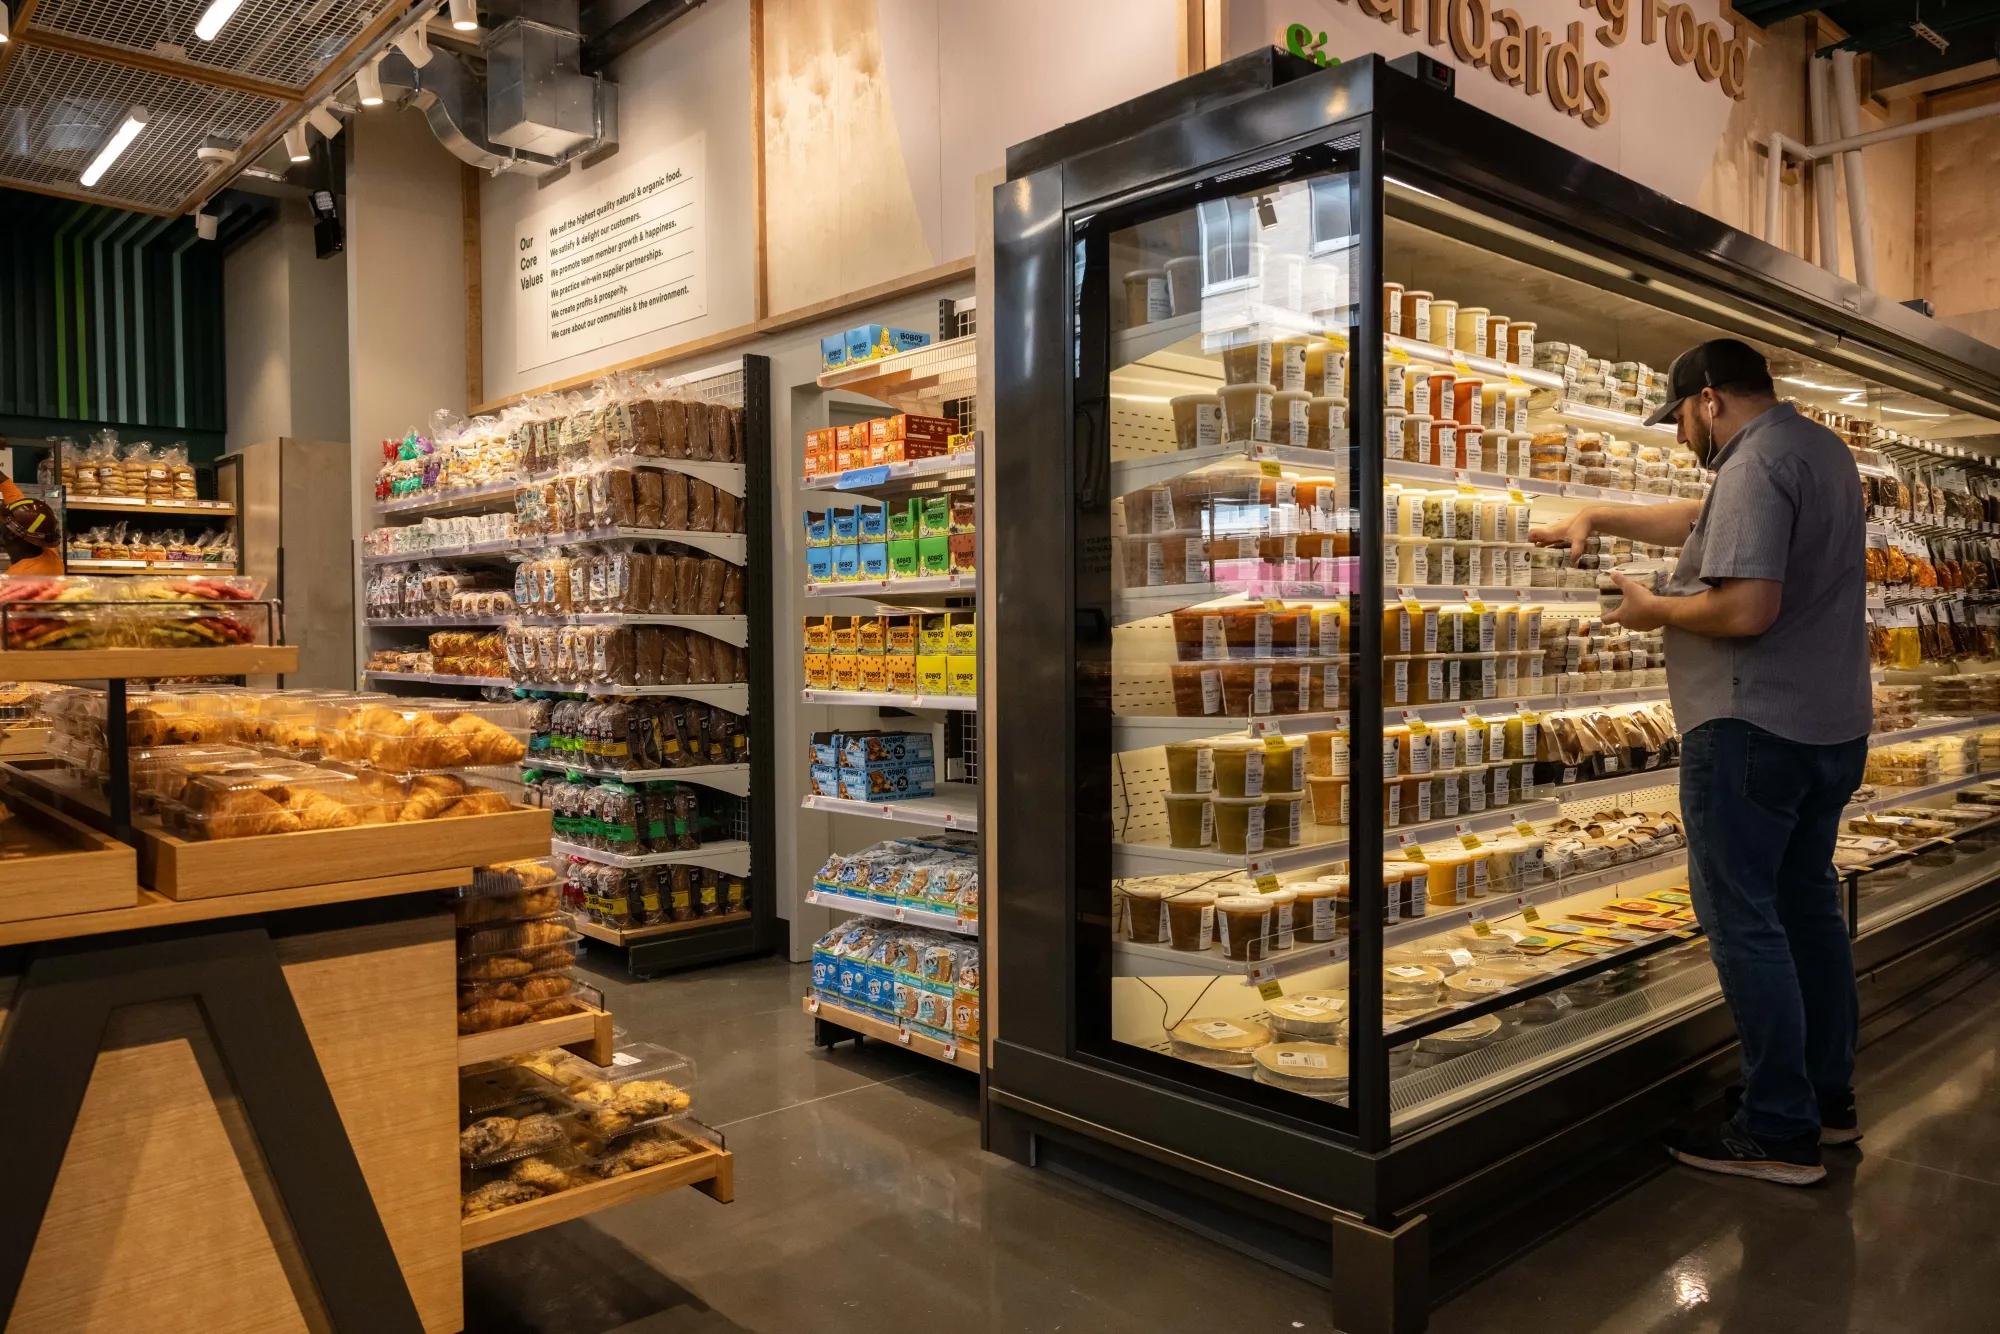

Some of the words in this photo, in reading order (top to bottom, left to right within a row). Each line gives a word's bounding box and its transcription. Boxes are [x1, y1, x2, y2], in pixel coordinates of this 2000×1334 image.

[550, 228, 558, 237] We
[558, 222, 567, 233] sell
[567, 219, 576, 228] the
[576, 209, 596, 225] highest
[596, 200, 616, 216] quality
[616, 188, 637, 206] natural
[637, 186, 642, 197] &
[642, 176, 665, 194] organic
[666, 168, 682, 183] food.
[550, 248, 558, 258] We
[559, 240, 575, 254] satisfy
[576, 237, 581, 246] &
[581, 228, 600, 244] delight
[601, 226, 609, 235] our
[610, 212, 641, 231] customers.
[520, 237, 534, 251] Our
[550, 268, 559, 278] We
[559, 258, 580, 274] promote
[581, 252, 595, 265] team
[595, 244, 617, 259] member
[618, 233, 639, 252] growth
[639, 231, 644, 241] &
[645, 220, 677, 239] happiness.
[520, 255, 538, 271] Core
[551, 289, 559, 299] We
[559, 281, 580, 297] practice
[581, 271, 602, 287] win-win
[602, 263, 624, 279] supplier
[625, 248, 664, 271] partnerships.
[520, 273, 544, 291] Values
[551, 309, 559, 319] We
[560, 304, 576, 316] create
[576, 297, 593, 312] profits
[594, 294, 598, 304] &
[599, 284, 628, 304] prosperity.
[551, 330, 559, 339] We
[560, 327, 571, 337] care
[571, 320, 587, 333] about
[587, 317, 596, 328] our
[597, 307, 632, 324] communities
[632, 303, 638, 312] &
[638, 296, 648, 309] the
[649, 285, 689, 306] environment.
[900, 332, 923, 343] BOBO'S
[828, 349, 842, 359] BOBO'S
[853, 342, 867, 351] BOBO'S
[928, 512, 944, 520] BOBO'S
[928, 554, 943, 562] BOBO'S
[812, 562, 826, 570] BOBO'S
[888, 768, 907, 776] BOBO'S
